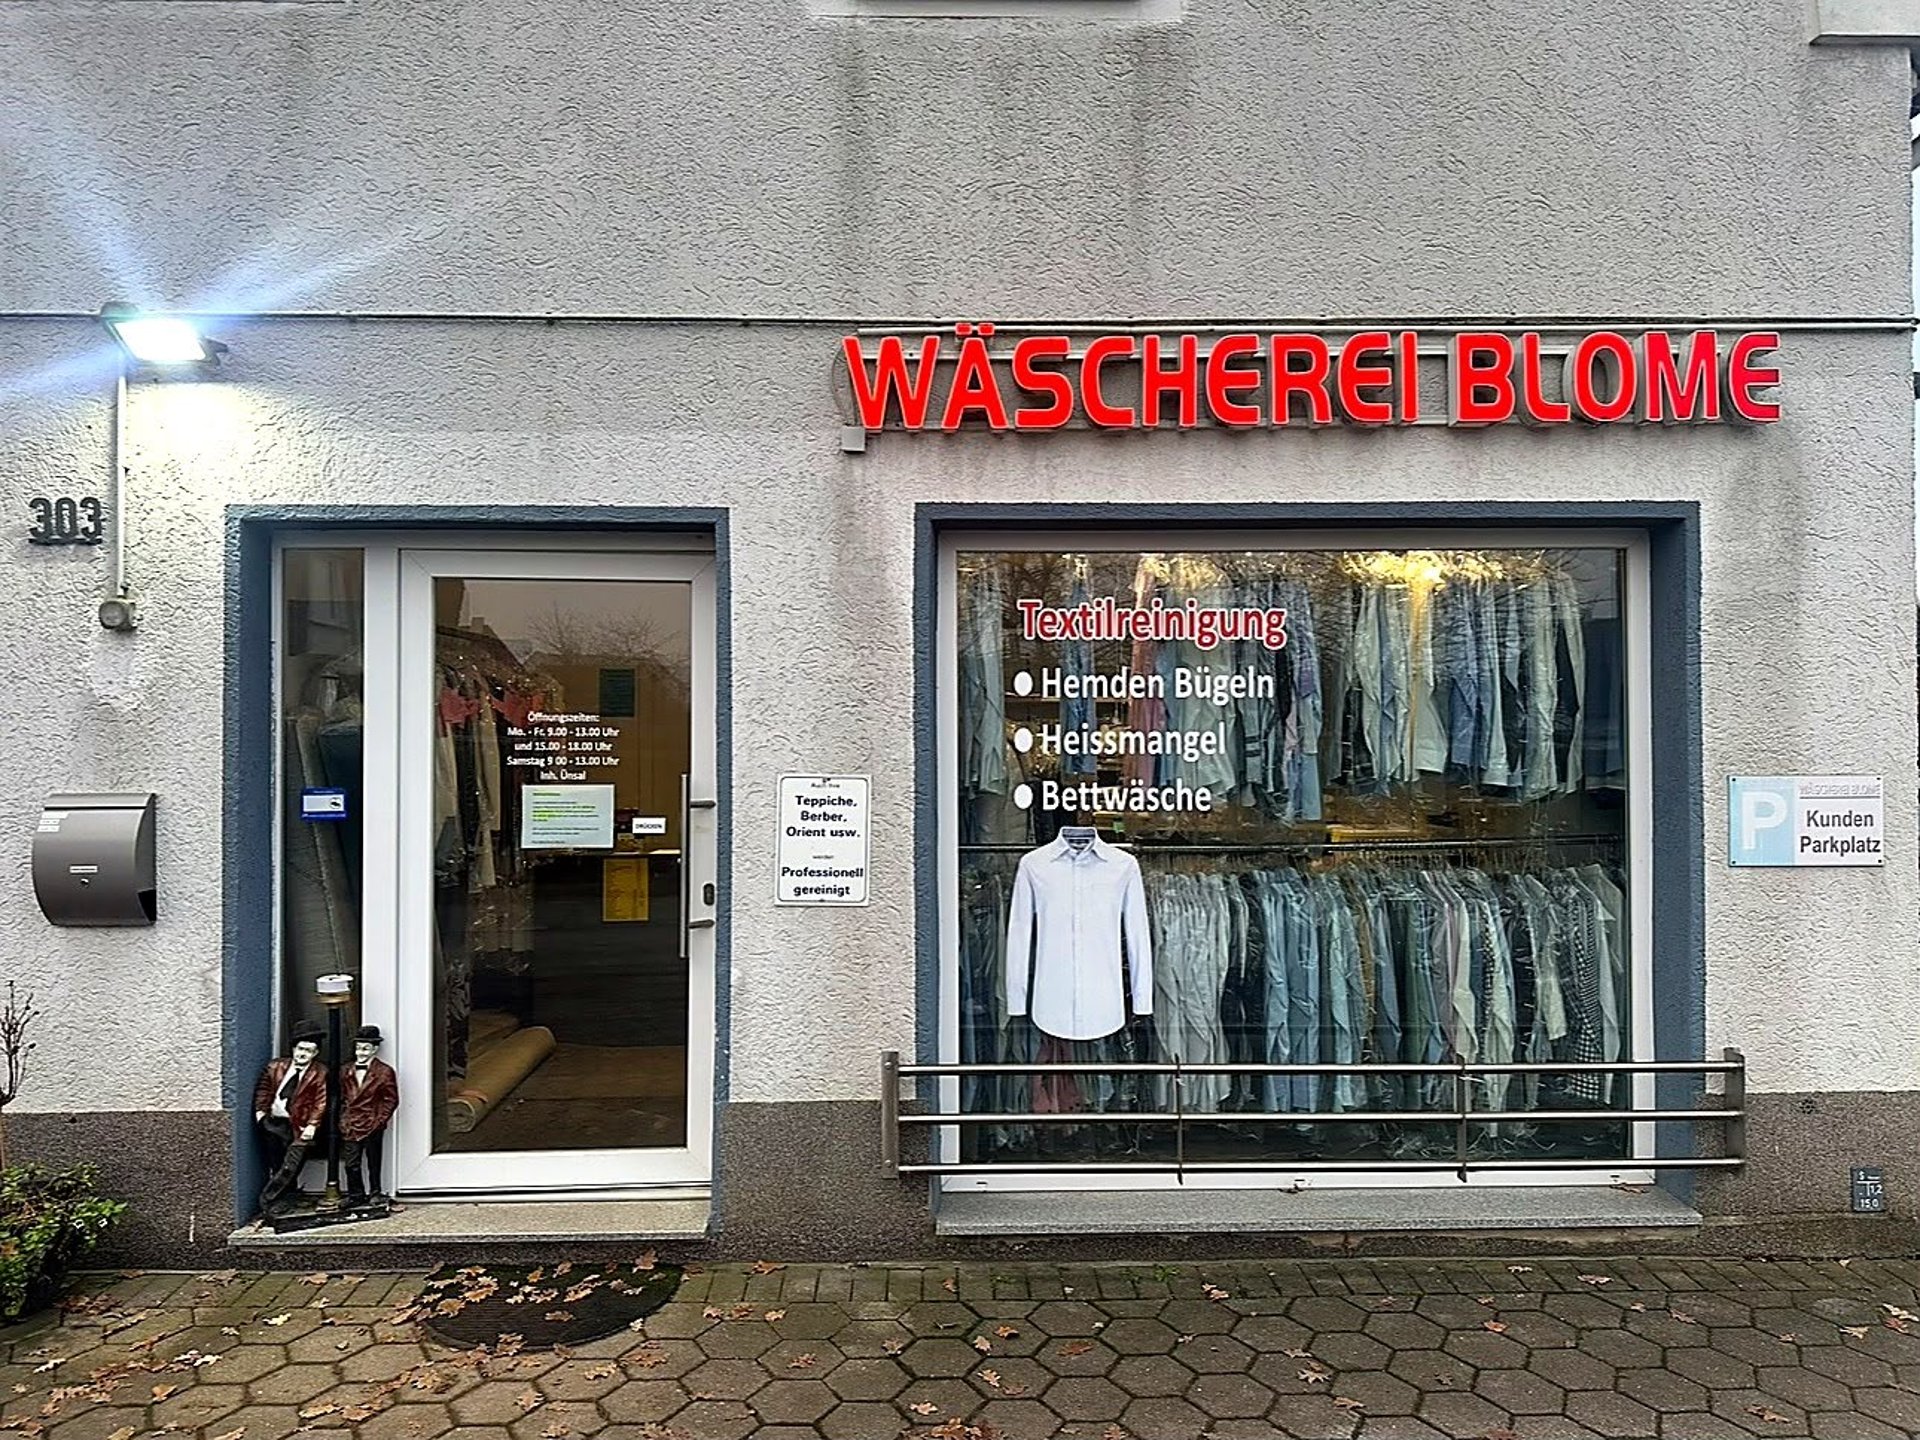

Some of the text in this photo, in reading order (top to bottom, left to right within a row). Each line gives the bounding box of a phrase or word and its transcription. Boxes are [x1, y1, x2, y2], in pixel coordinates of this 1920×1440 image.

[842, 322, 1781, 429] WÄSCHEREI BLOME
[29, 497, 102, 540] 303
[1018, 598, 1288, 649] Textilreinigung
[1042, 666, 1275, 706] Hemden Bügeln
[527, 711, 600, 723] Öffnungszeiten:
[507, 727, 526, 736] Mo.
[575, 727, 600, 737] 13.00
[602, 727, 620, 737] Uhr
[514, 742, 532, 751] und
[534, 742, 560, 751] 15.00
[567, 742, 593, 751] 18.00
[595, 742, 613, 751] Uhr
[1041, 721, 1226, 763] Heissmangel
[506, 756, 545, 767] Samstag
[574, 756, 600, 766] 13.00
[602, 757, 620, 766] Uhr
[540, 771, 558, 780] Inh.
[1042, 778, 1212, 812] Bettwäsche
[1742, 791, 1787, 850] P
[1806, 810, 1874, 827] Kunden
[786, 826, 861, 837] Orient usw.
[1800, 836, 1881, 857] Parkplatz
[781, 866, 864, 877] Professionell
[793, 884, 850, 897] gereinigt
